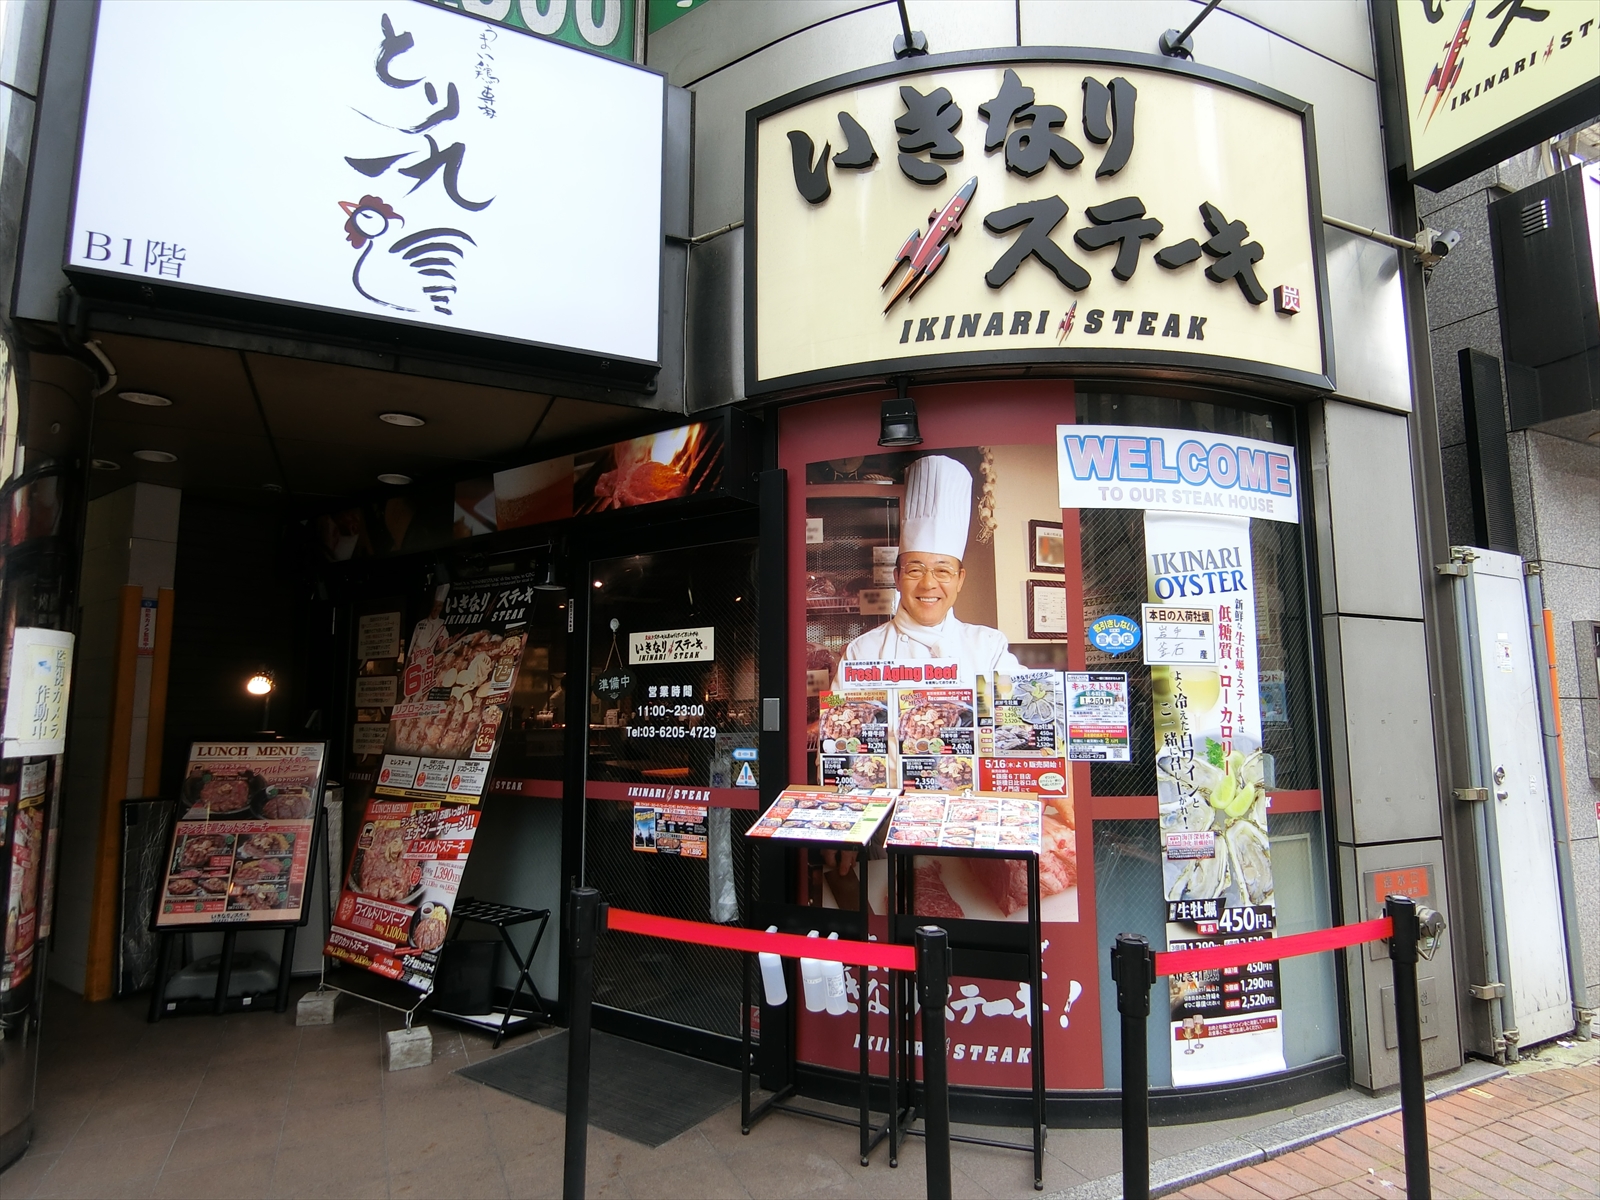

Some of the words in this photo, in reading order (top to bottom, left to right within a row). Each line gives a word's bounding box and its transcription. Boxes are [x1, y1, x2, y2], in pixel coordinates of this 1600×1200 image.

[1450, 51, 1537, 112] IKINARI
[1559, 18, 1600, 51] ST
[787, 68, 1138, 206] いきなり
[82, 229, 187, 279] B1階
[984, 194, 1268, 305] ステーキ
[899, 307, 1050, 345] IKINARI
[1082, 311, 1208, 344] STEAK
[1064, 434, 1292, 497] WELCOME
[1098, 486, 1124, 502] TO
[1129, 487, 1167, 503] OUR
[1172, 490, 1224, 508] STEAK
[1228, 494, 1274, 514] HOUSE
[1151, 547, 1242, 576] IKINARI
[1154, 569, 1248, 600] OYSTER
[491, 607, 526, 622] STEAK
[1149, 610, 1210, 622] 本日の入荷牡蠣
[635, 640, 667, 654] いきなり
[674, 638, 703, 652] ステーキ
[638, 653, 667, 661] IKINARI
[673, 651, 700, 660] STEAK
[844, 666, 881, 682] Fresh
[882, 665, 922, 682] Aging
[924, 664, 958, 680] Beef
[599, 674, 630, 691] 準備中
[648, 685, 693, 698] 営業時間
[626, 726, 717, 739] Tel:03-6205-4729
[197, 746, 249, 756] LUNCH
[256, 746, 299, 756] MENU
[495, 780, 523, 791] STEAK
[628, 786, 666, 798] IKINARI
[673, 789, 711, 801] STEAK
[953, 1043, 1031, 1064] STEAK
